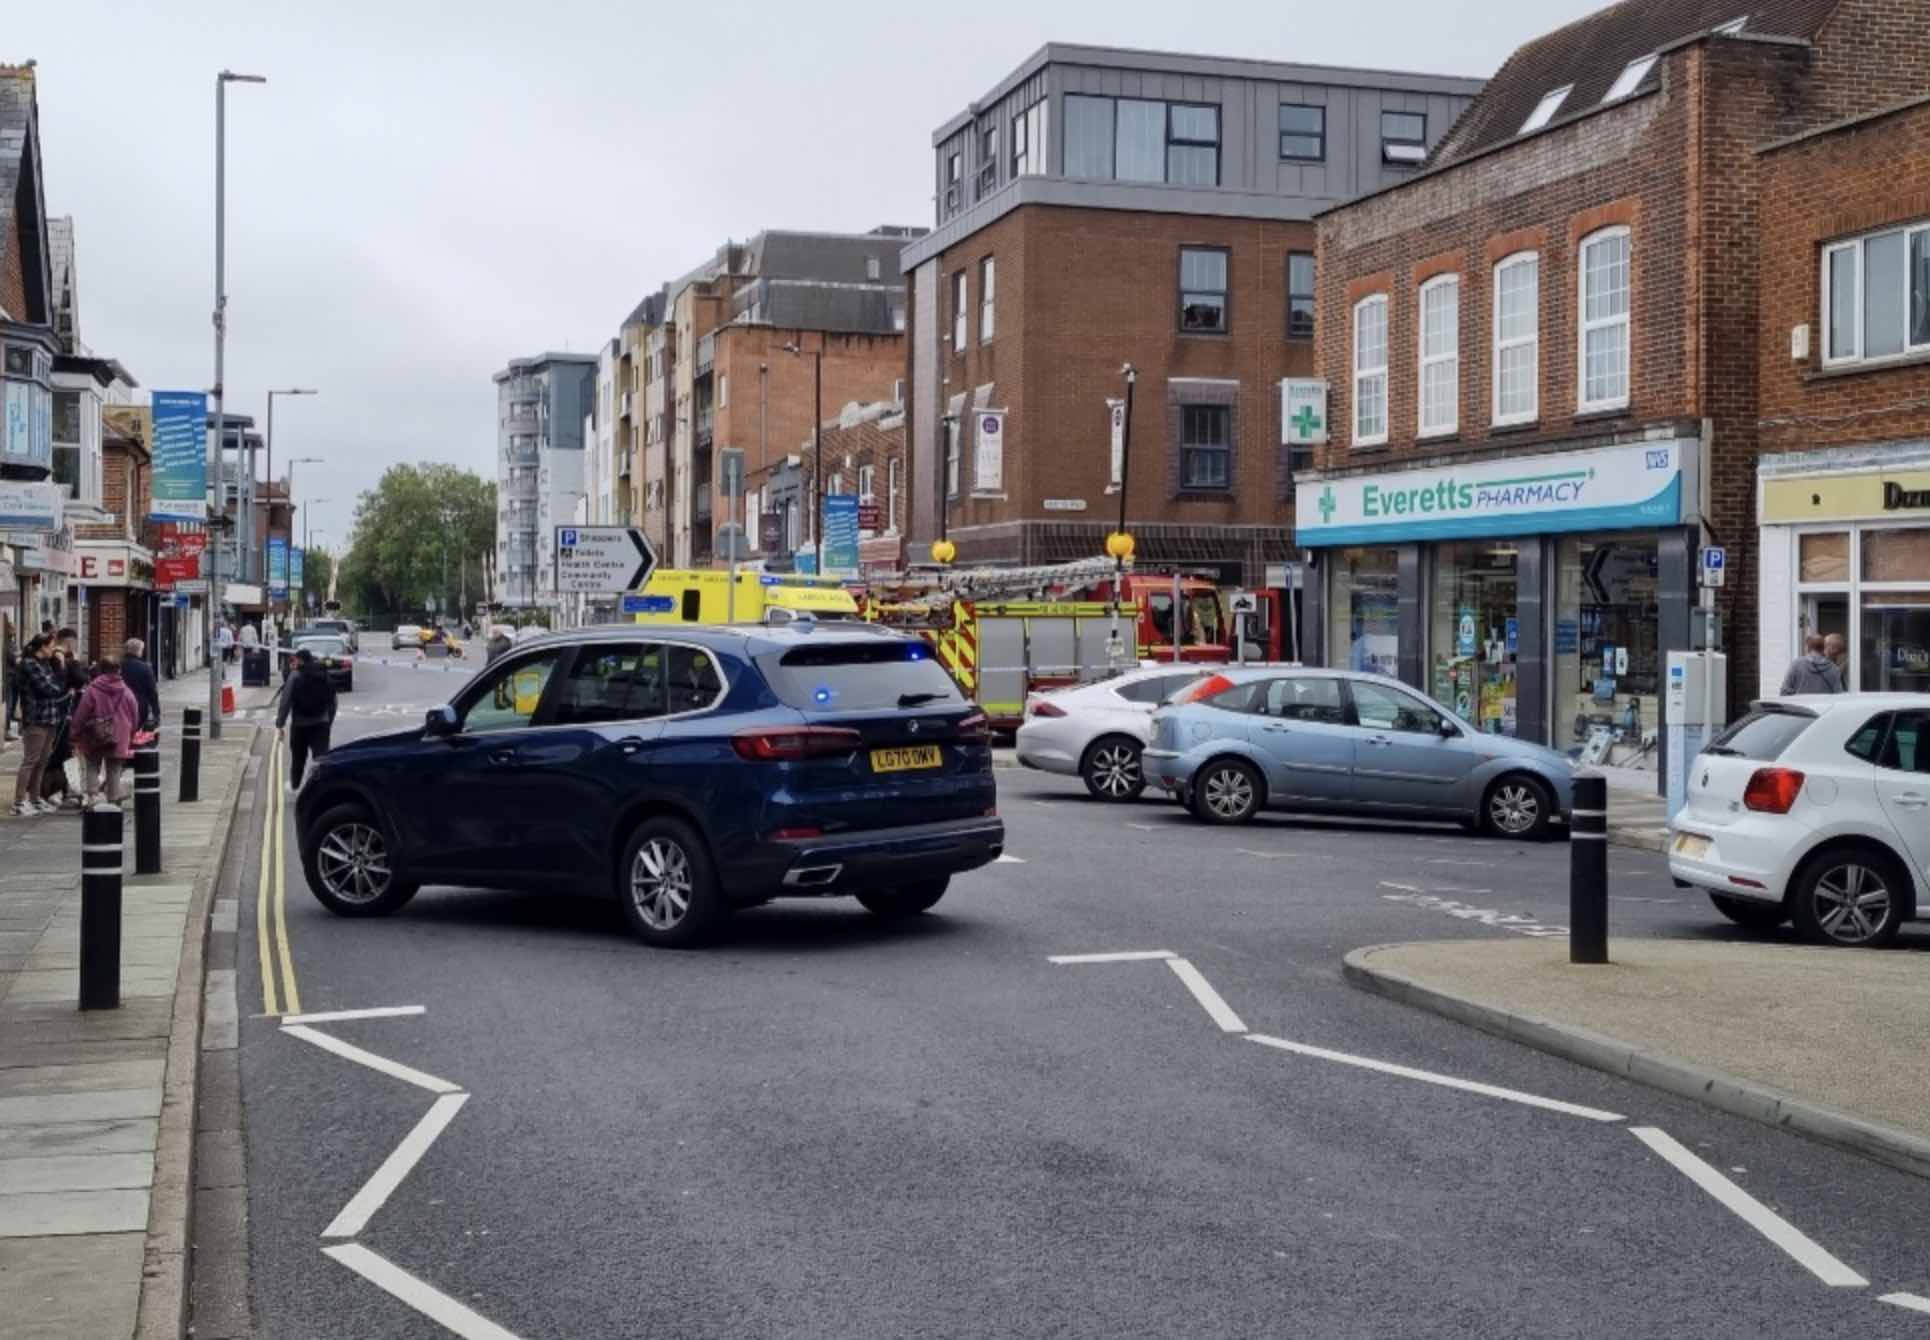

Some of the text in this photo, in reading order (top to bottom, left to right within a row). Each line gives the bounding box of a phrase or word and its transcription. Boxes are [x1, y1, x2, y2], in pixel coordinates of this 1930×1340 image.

[1362, 480, 1585, 517] Everetts PHARMACY
[1710, 551, 1721, 568] P
